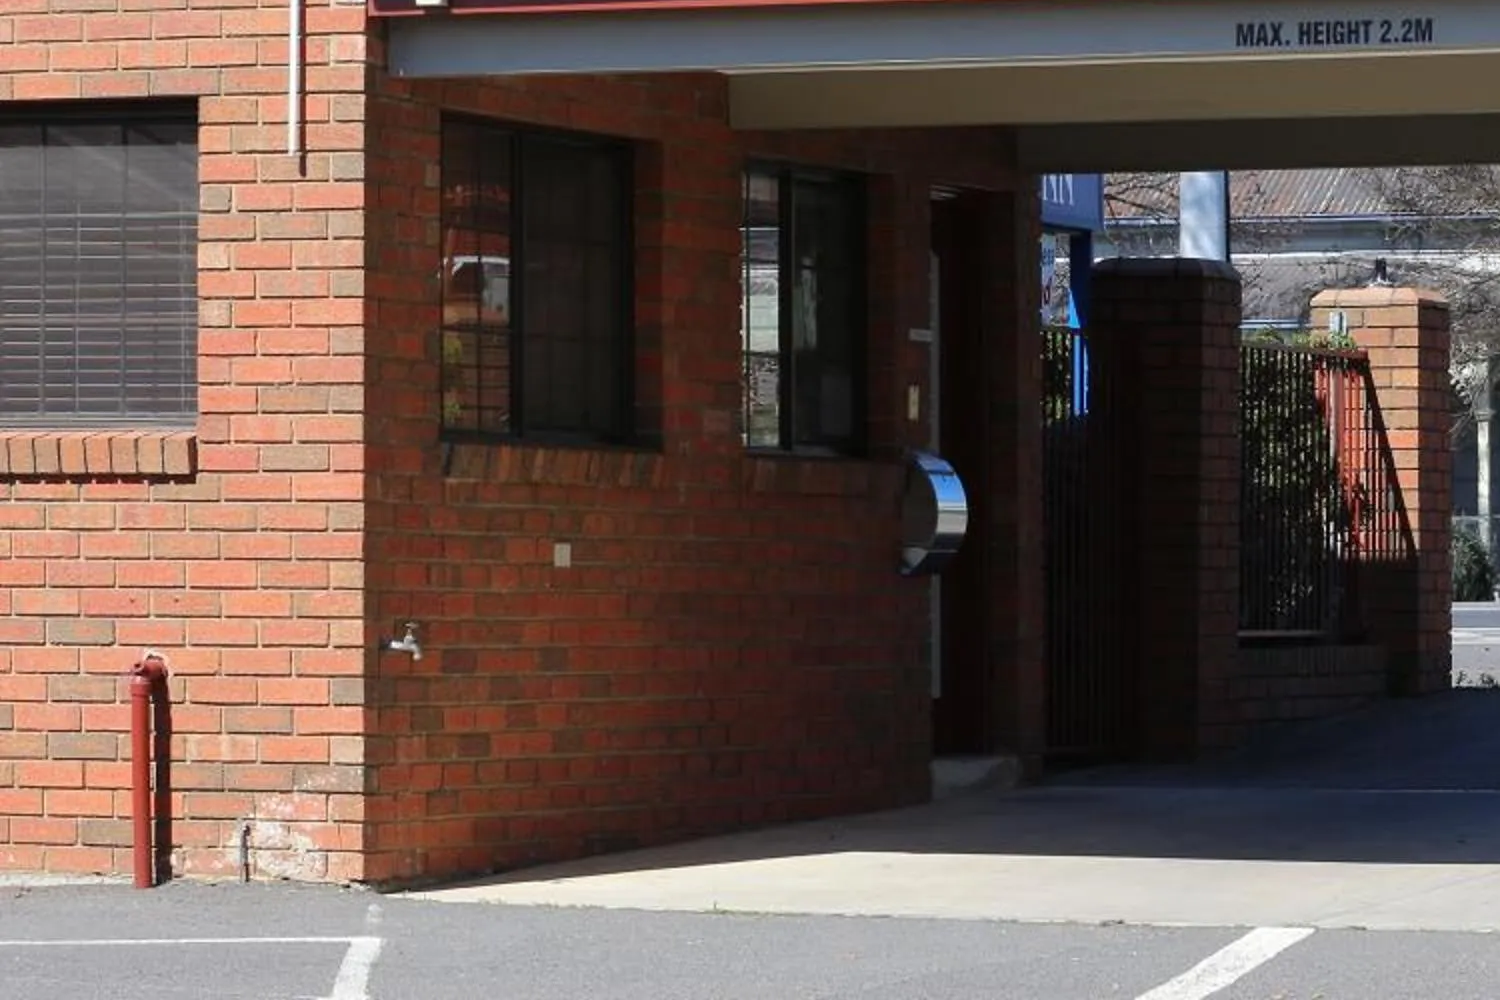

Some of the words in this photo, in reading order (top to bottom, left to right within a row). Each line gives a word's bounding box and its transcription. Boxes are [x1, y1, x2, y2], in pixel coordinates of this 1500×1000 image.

[1235, 22, 1290, 47] MAX.
[1298, 20, 1372, 45] HEIGHT
[1379, 17, 1433, 43] 2.2M
